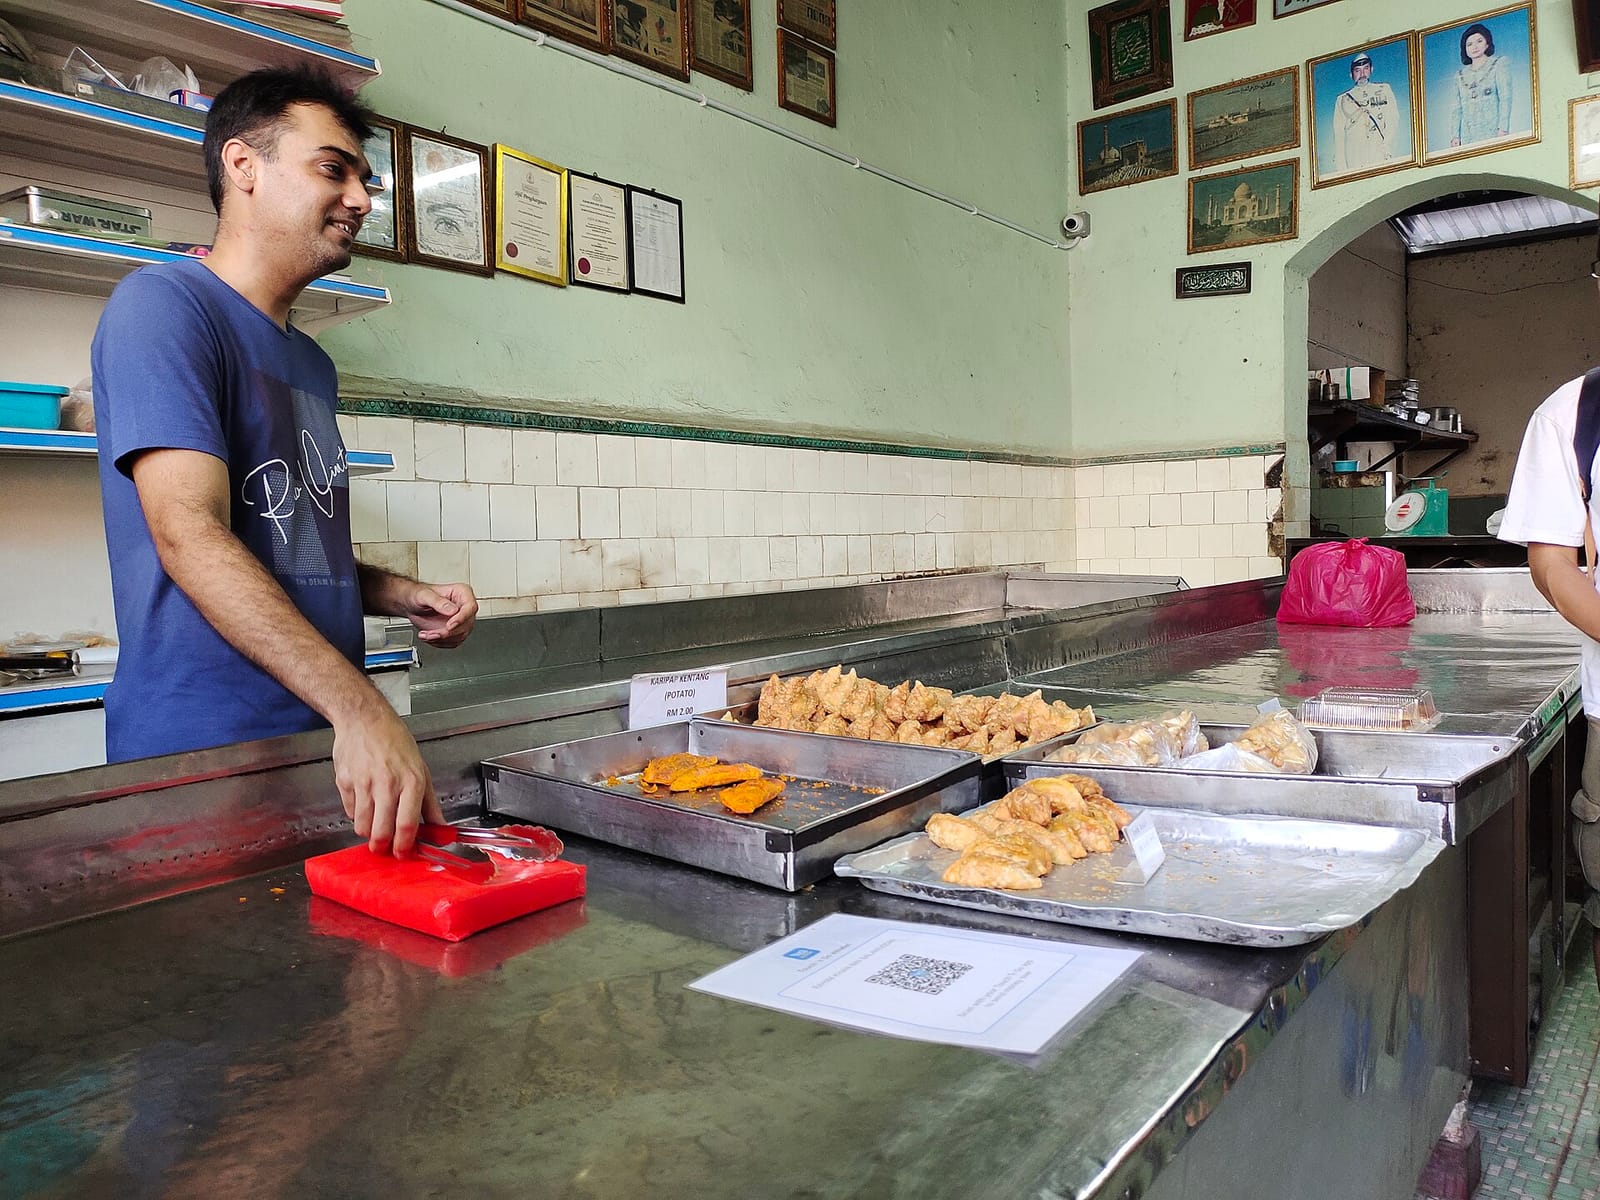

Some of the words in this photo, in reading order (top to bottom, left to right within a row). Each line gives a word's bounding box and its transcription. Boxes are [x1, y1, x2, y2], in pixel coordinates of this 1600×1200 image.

[97, 218, 142, 235] STAR
[650, 675, 679, 686] KARIPAP
[680, 672, 710, 683] KENTANG
[664, 688, 696, 701] (POTATO)
[666, 708, 678, 718] RM
[679, 706, 694, 716] 2.00
